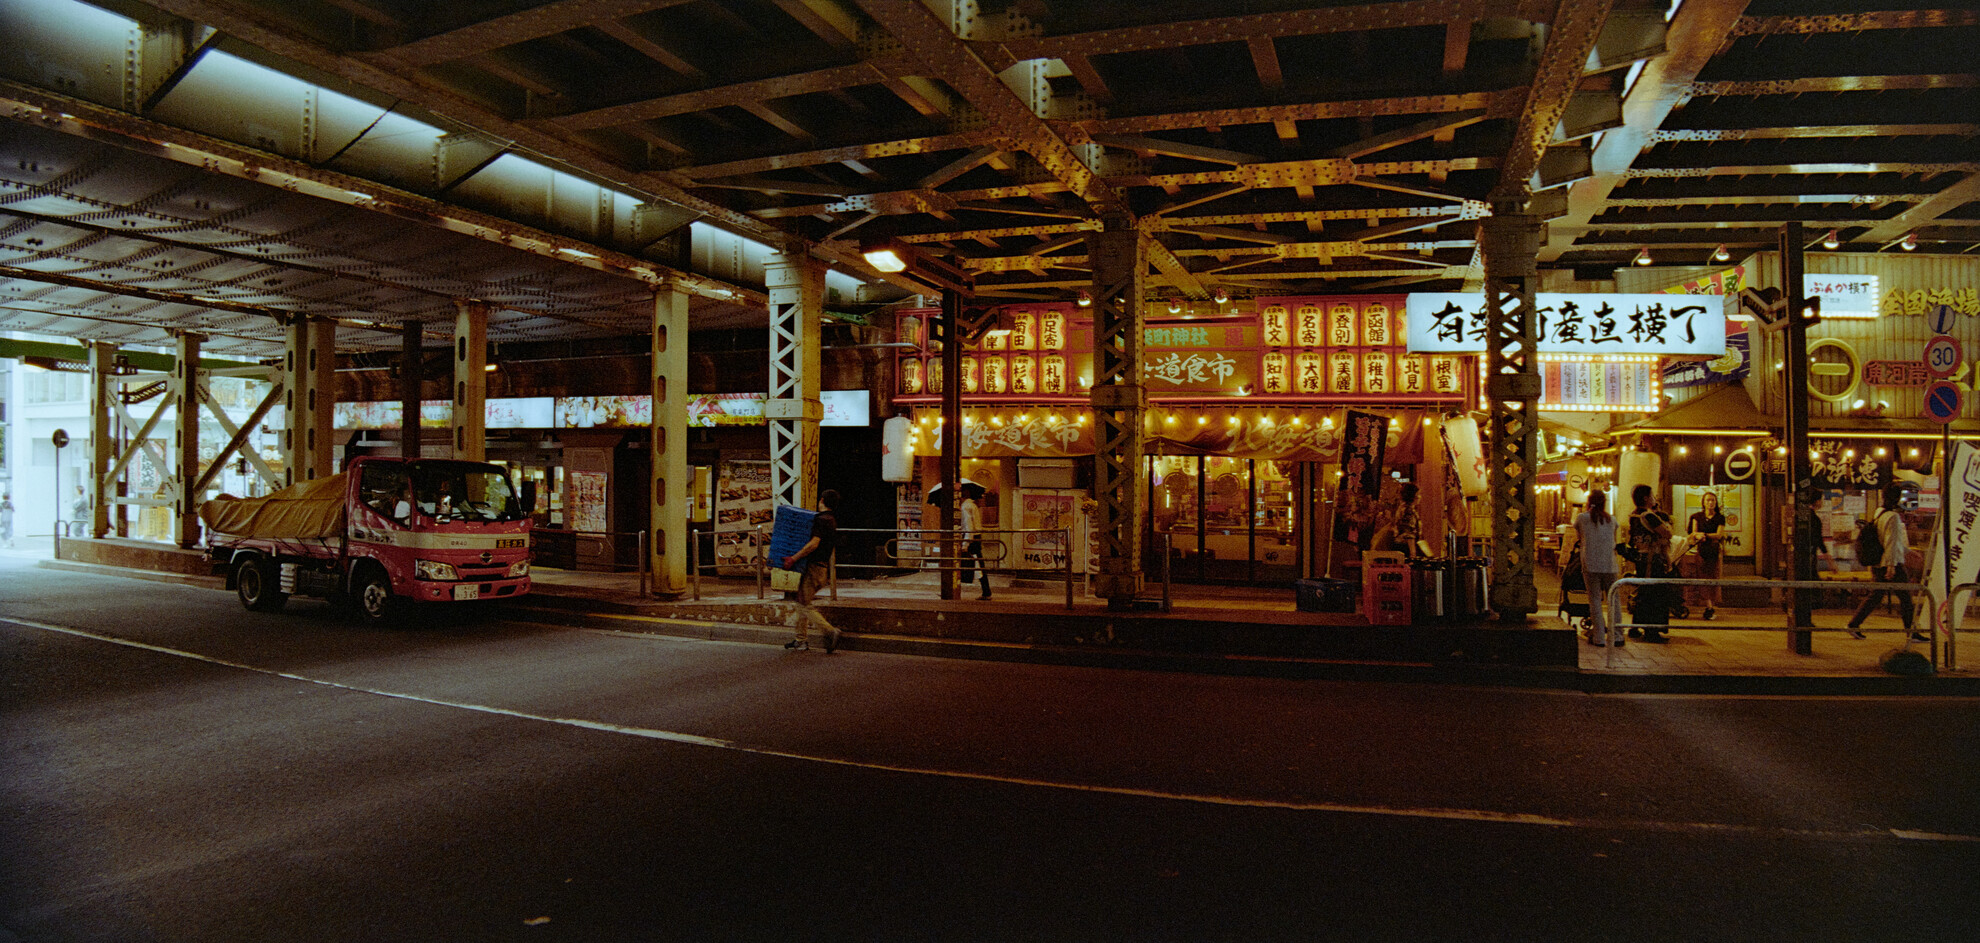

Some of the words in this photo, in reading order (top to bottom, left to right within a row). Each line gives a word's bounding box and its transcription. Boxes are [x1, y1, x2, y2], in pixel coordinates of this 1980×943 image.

[1267, 314, 1282, 343] 礼文
[1302, 314, 1317, 343] 名寄
[1335, 314, 1350, 343] 登別
[1369, 314, 1384, 343] 函館
[1145, 353, 1236, 385] 道食市
[1932, 347, 1953, 366] 30
[1046, 365, 1060, 391] 札幌
[1267, 362, 1282, 390] 知床
[1303, 362, 1318, 390] 大塚
[1368, 362, 1383, 390] 稚内
[1405, 361, 1419, 390] 北見
[1436, 361, 1451, 389] 根室
